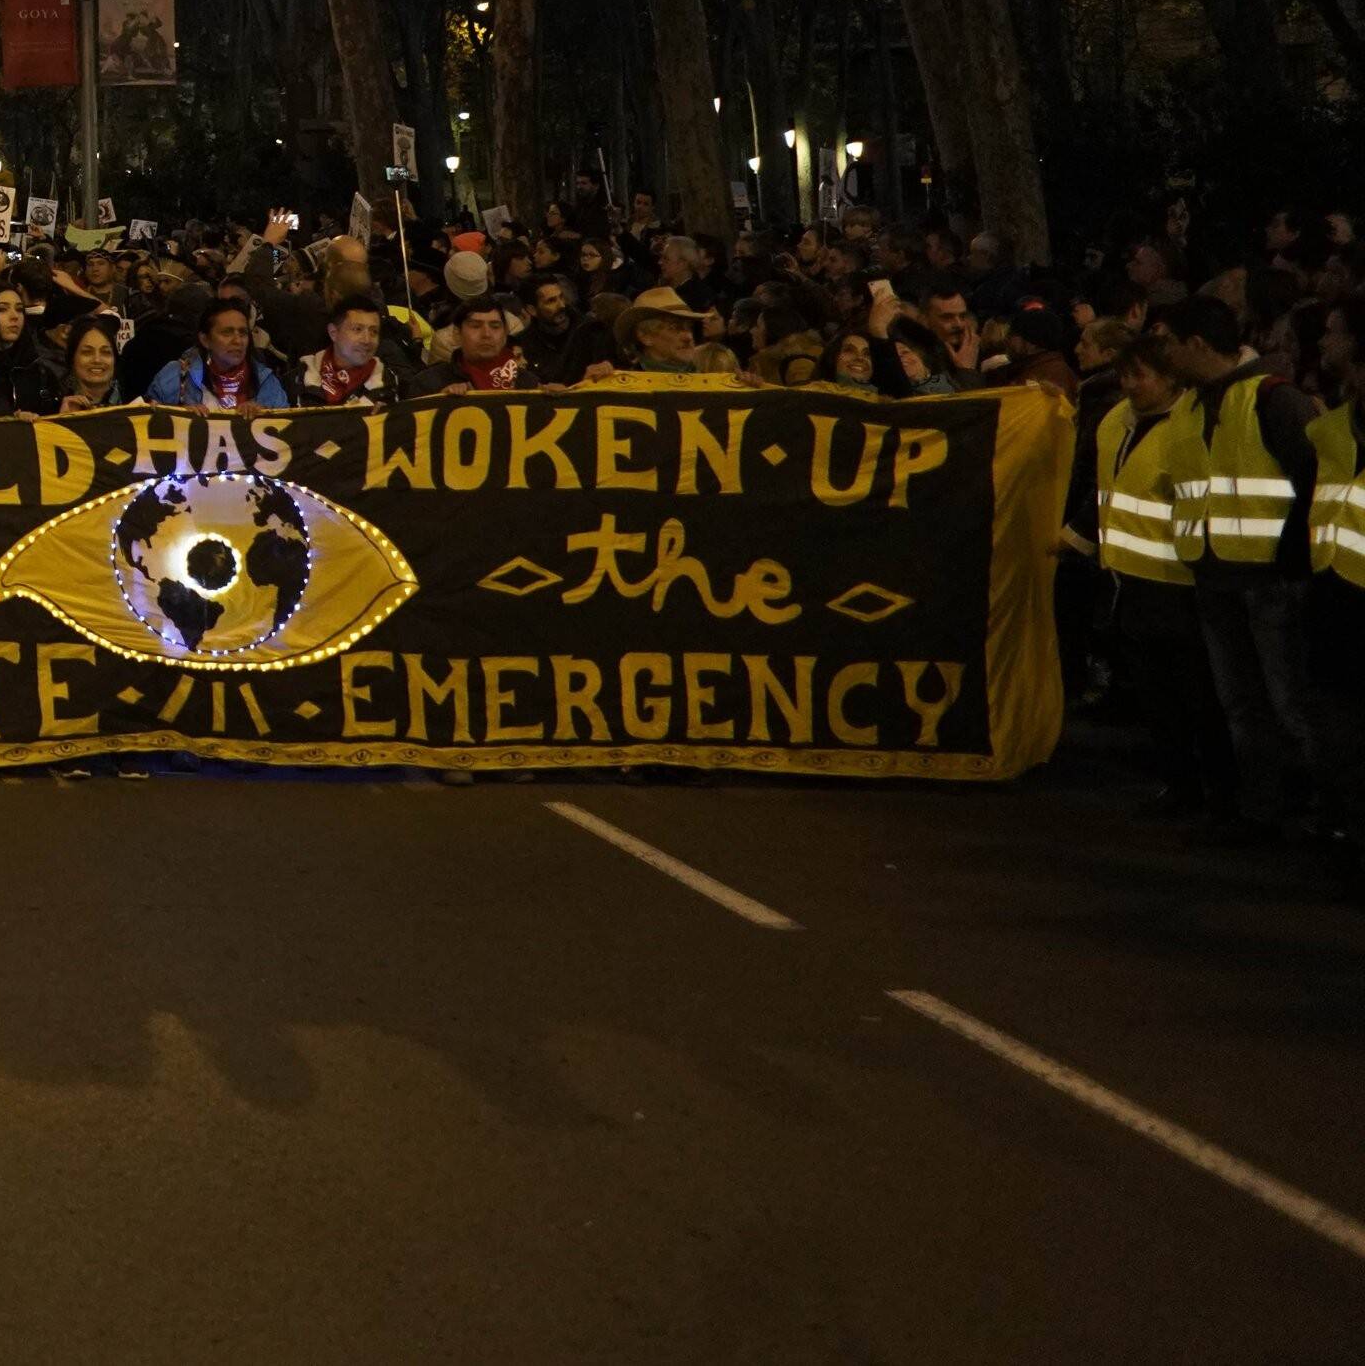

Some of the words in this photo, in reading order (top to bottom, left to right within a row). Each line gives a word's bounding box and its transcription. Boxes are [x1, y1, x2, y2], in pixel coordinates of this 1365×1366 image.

[19, 9, 60, 19] GOYA
[132, 414, 293, 478] HAS
[362, 405, 756, 494] WOKEN
[808, 412, 950, 510] UP
[561, 512, 803, 624] the
[340, 653, 967, 747] EMERGENCY
